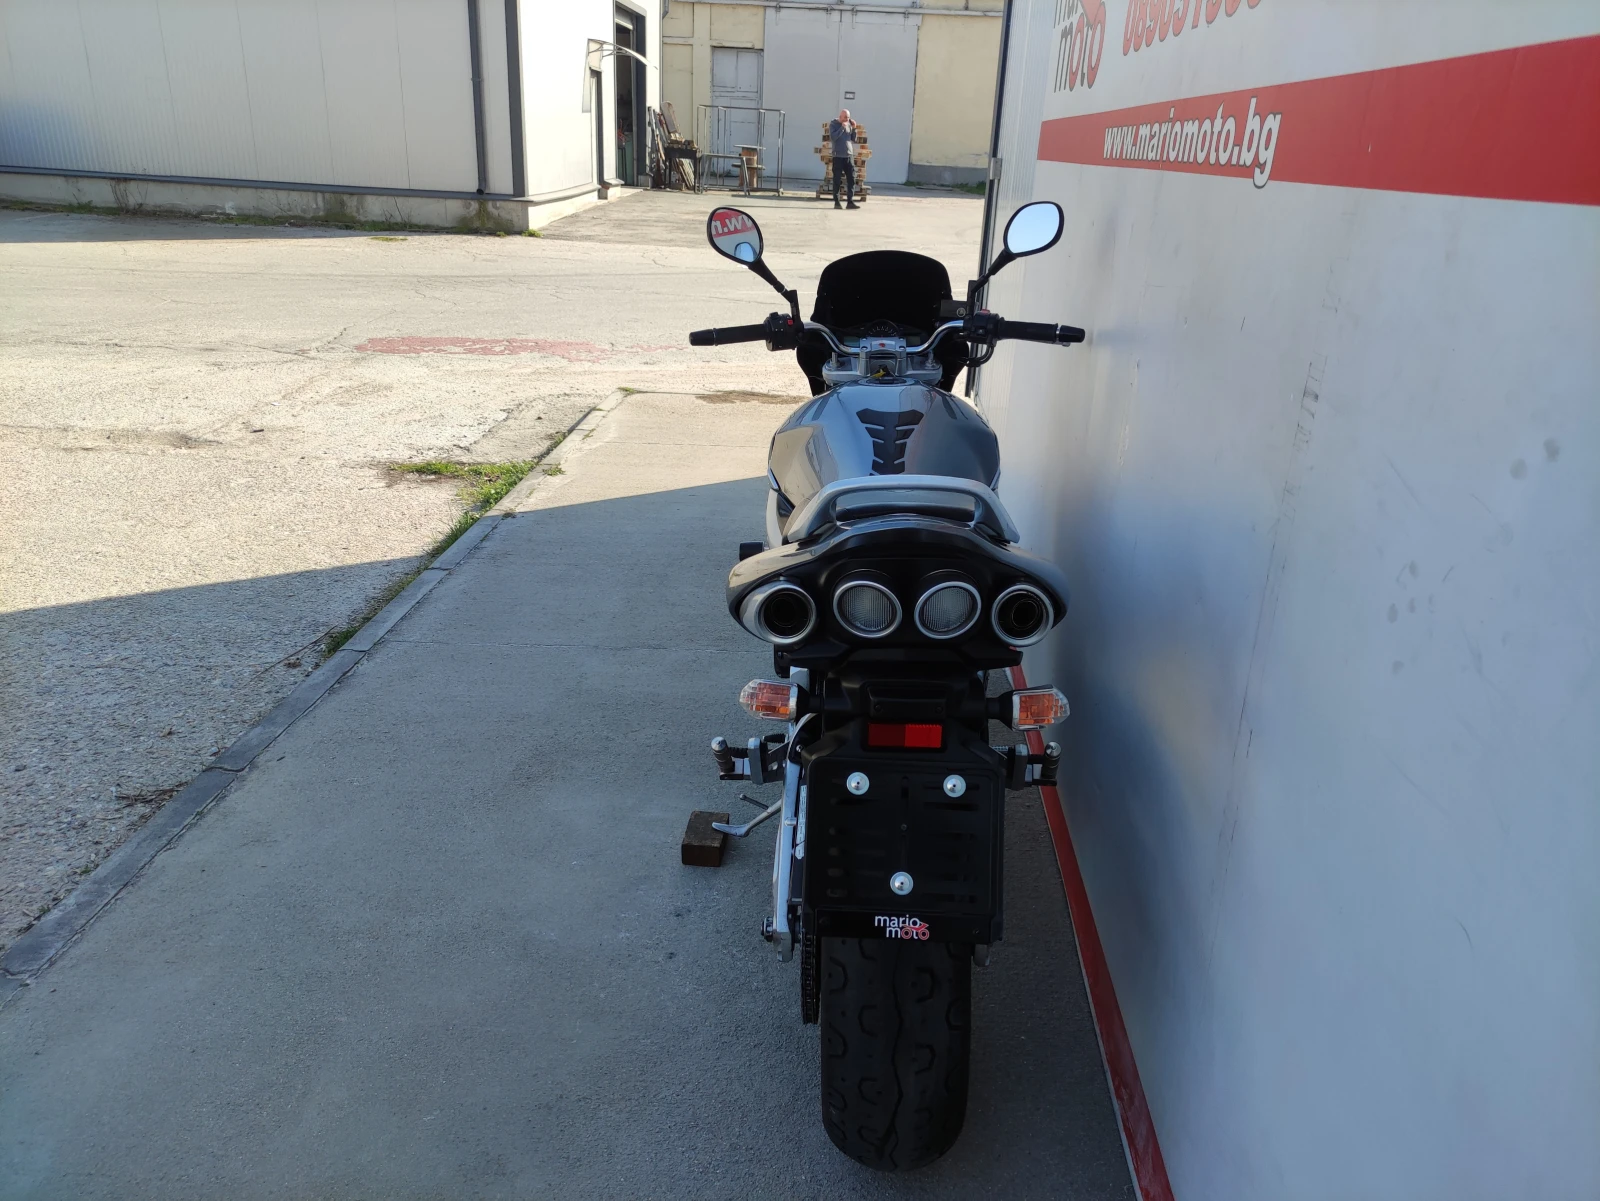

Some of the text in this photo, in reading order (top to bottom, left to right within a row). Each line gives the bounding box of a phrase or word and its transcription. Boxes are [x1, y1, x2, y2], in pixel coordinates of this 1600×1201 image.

[1054, 2, 1106, 93] moto
[1103, 96, 1282, 189] www.mariomoto.bg
[874, 914, 920, 928] mario
[886, 927, 929, 940] moto
